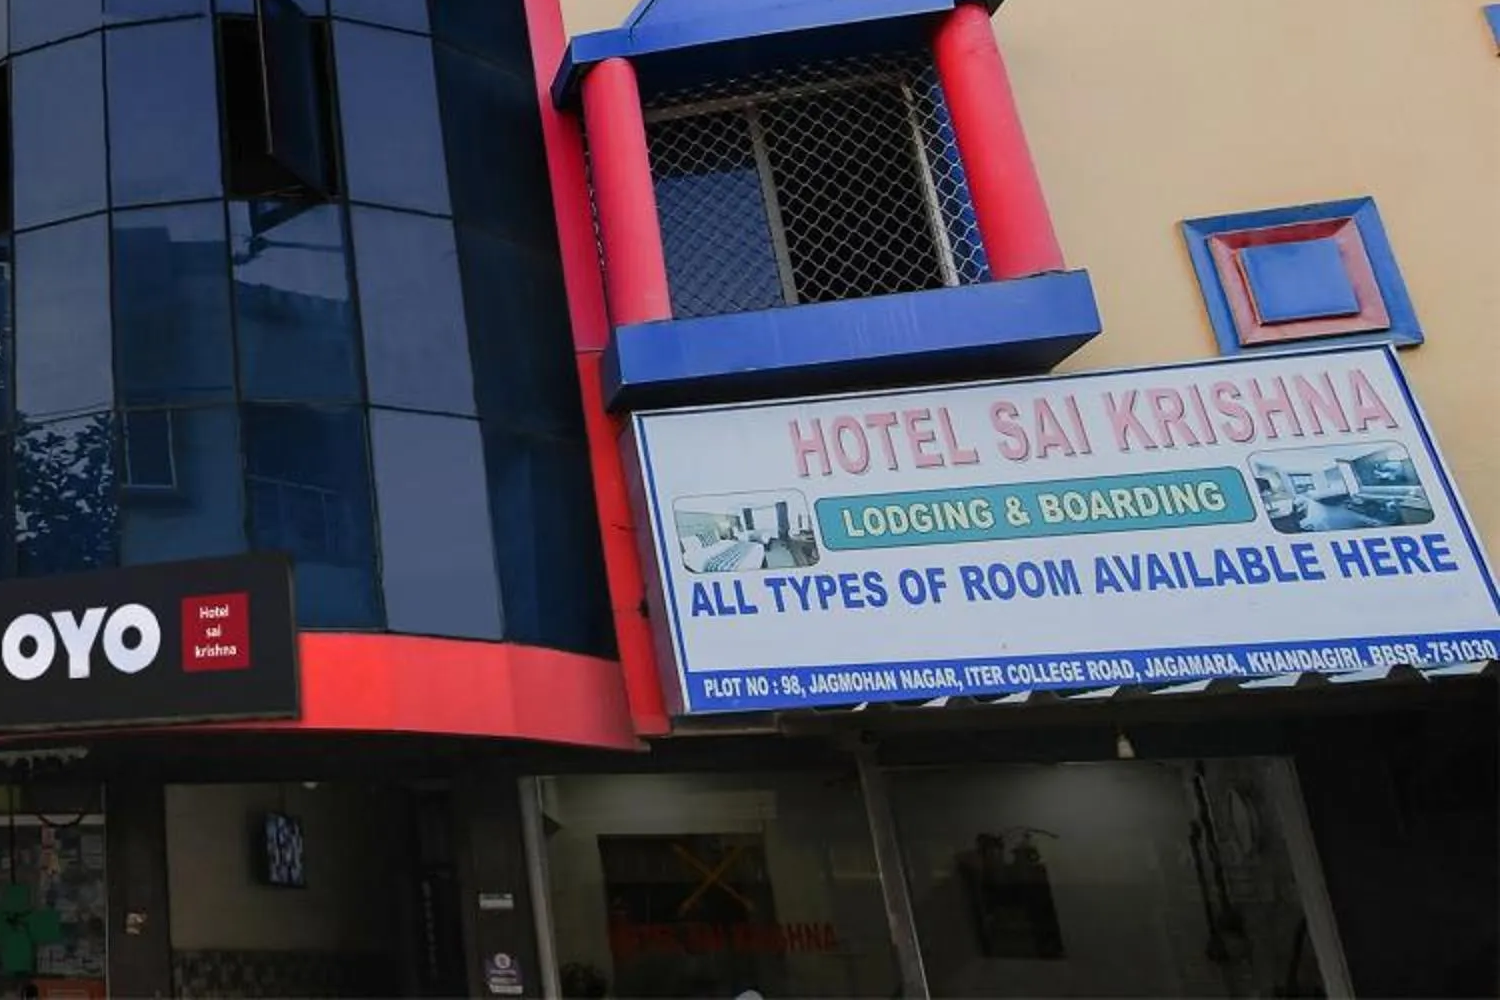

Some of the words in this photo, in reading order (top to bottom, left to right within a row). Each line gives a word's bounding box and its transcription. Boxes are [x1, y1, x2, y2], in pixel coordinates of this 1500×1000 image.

[789, 406, 980, 478] HOTEL
[988, 394, 1092, 463] SAI
[1103, 369, 1400, 452] KRISHNA
[841, 497, 996, 539] LODGING
[1004, 494, 1030, 527] &
[1038, 480, 1227, 524] BOARDING
[690, 579, 760, 618] ALL
[765, 571, 890, 614] TYPES
[899, 566, 952, 605] OF
[959, 557, 1082, 603] ROOM
[1094, 542, 1328, 596] AVAILABLE
[1329, 533, 1460, 579] HERE
[199, 604, 230, 619] Hotel
[1, 603, 161, 681] OYO
[195, 645, 238, 659] krishna
[703, 676, 744, 698] PLOT
[746, 676, 770, 696] NO
[808, 669, 898, 695] JAGMOHAN
[900, 667, 964, 692] NAGAR,
[964, 664, 1004, 687] ITER
[1006, 661, 1085, 686] COLLEGE
[1086, 659, 1142, 683] ROAD,
[1143, 653, 1247, 679] JAGAMARA,
